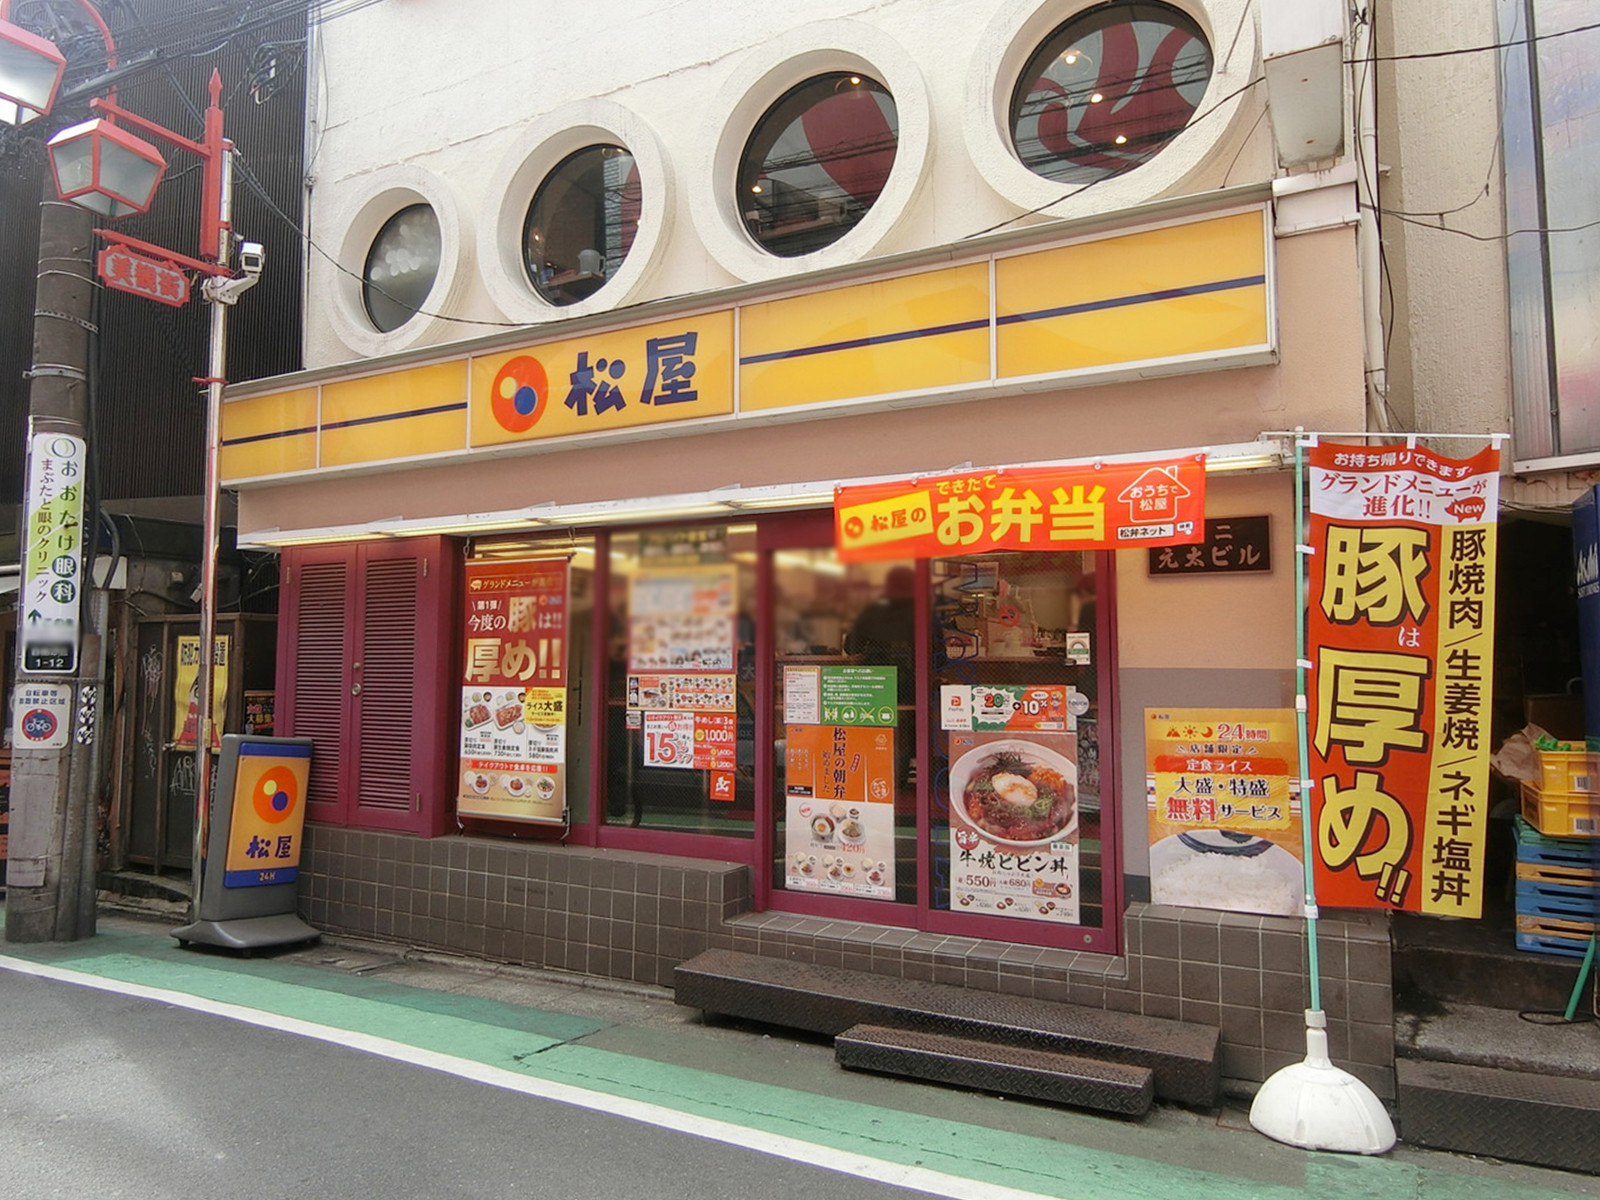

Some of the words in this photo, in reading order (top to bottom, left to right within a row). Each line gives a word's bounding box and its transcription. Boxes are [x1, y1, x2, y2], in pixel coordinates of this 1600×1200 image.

[564, 332, 698, 417] 松屋
[1334, 451, 1471, 478] お持ち帰りできます
[936, 474, 997, 496] できたて
[1130, 484, 1179, 499] おうちで
[1319, 472, 1488, 498] グランドメニューが
[936, 485, 1107, 546] お弁当
[1139, 498, 1168, 511] 松屋
[1363, 494, 1431, 519] 進化!!
[1453, 501, 1484, 515] New
[35, 458, 55, 604] まぶたと眼のクリニック
[871, 507, 927, 532] 松屋の
[52, 460, 79, 603] おおたけ眼科
[1119, 526, 1167, 538] 松弁ネット
[36, 658, 64, 668] 1-12
[465, 638, 561, 682] 厚め!!
[25, 689, 58, 697] 自転車等
[526, 700, 563, 711] ライス大盛
[1217, 723, 1269, 741] 24時間
[1189, 743, 1243, 755] 店舗限定
[833, 726, 847, 799] 松屋の朝弁
[1186, 758, 1253, 772] 定食ライス
[1175, 776, 1270, 797] 大盛・特盛
[1166, 796, 1283, 822] 無料サービス
[246, 835, 292, 859] 松屋
[960, 849, 1068, 876] 牛焼ビビン丼
[259, 872, 275, 881] 24H
